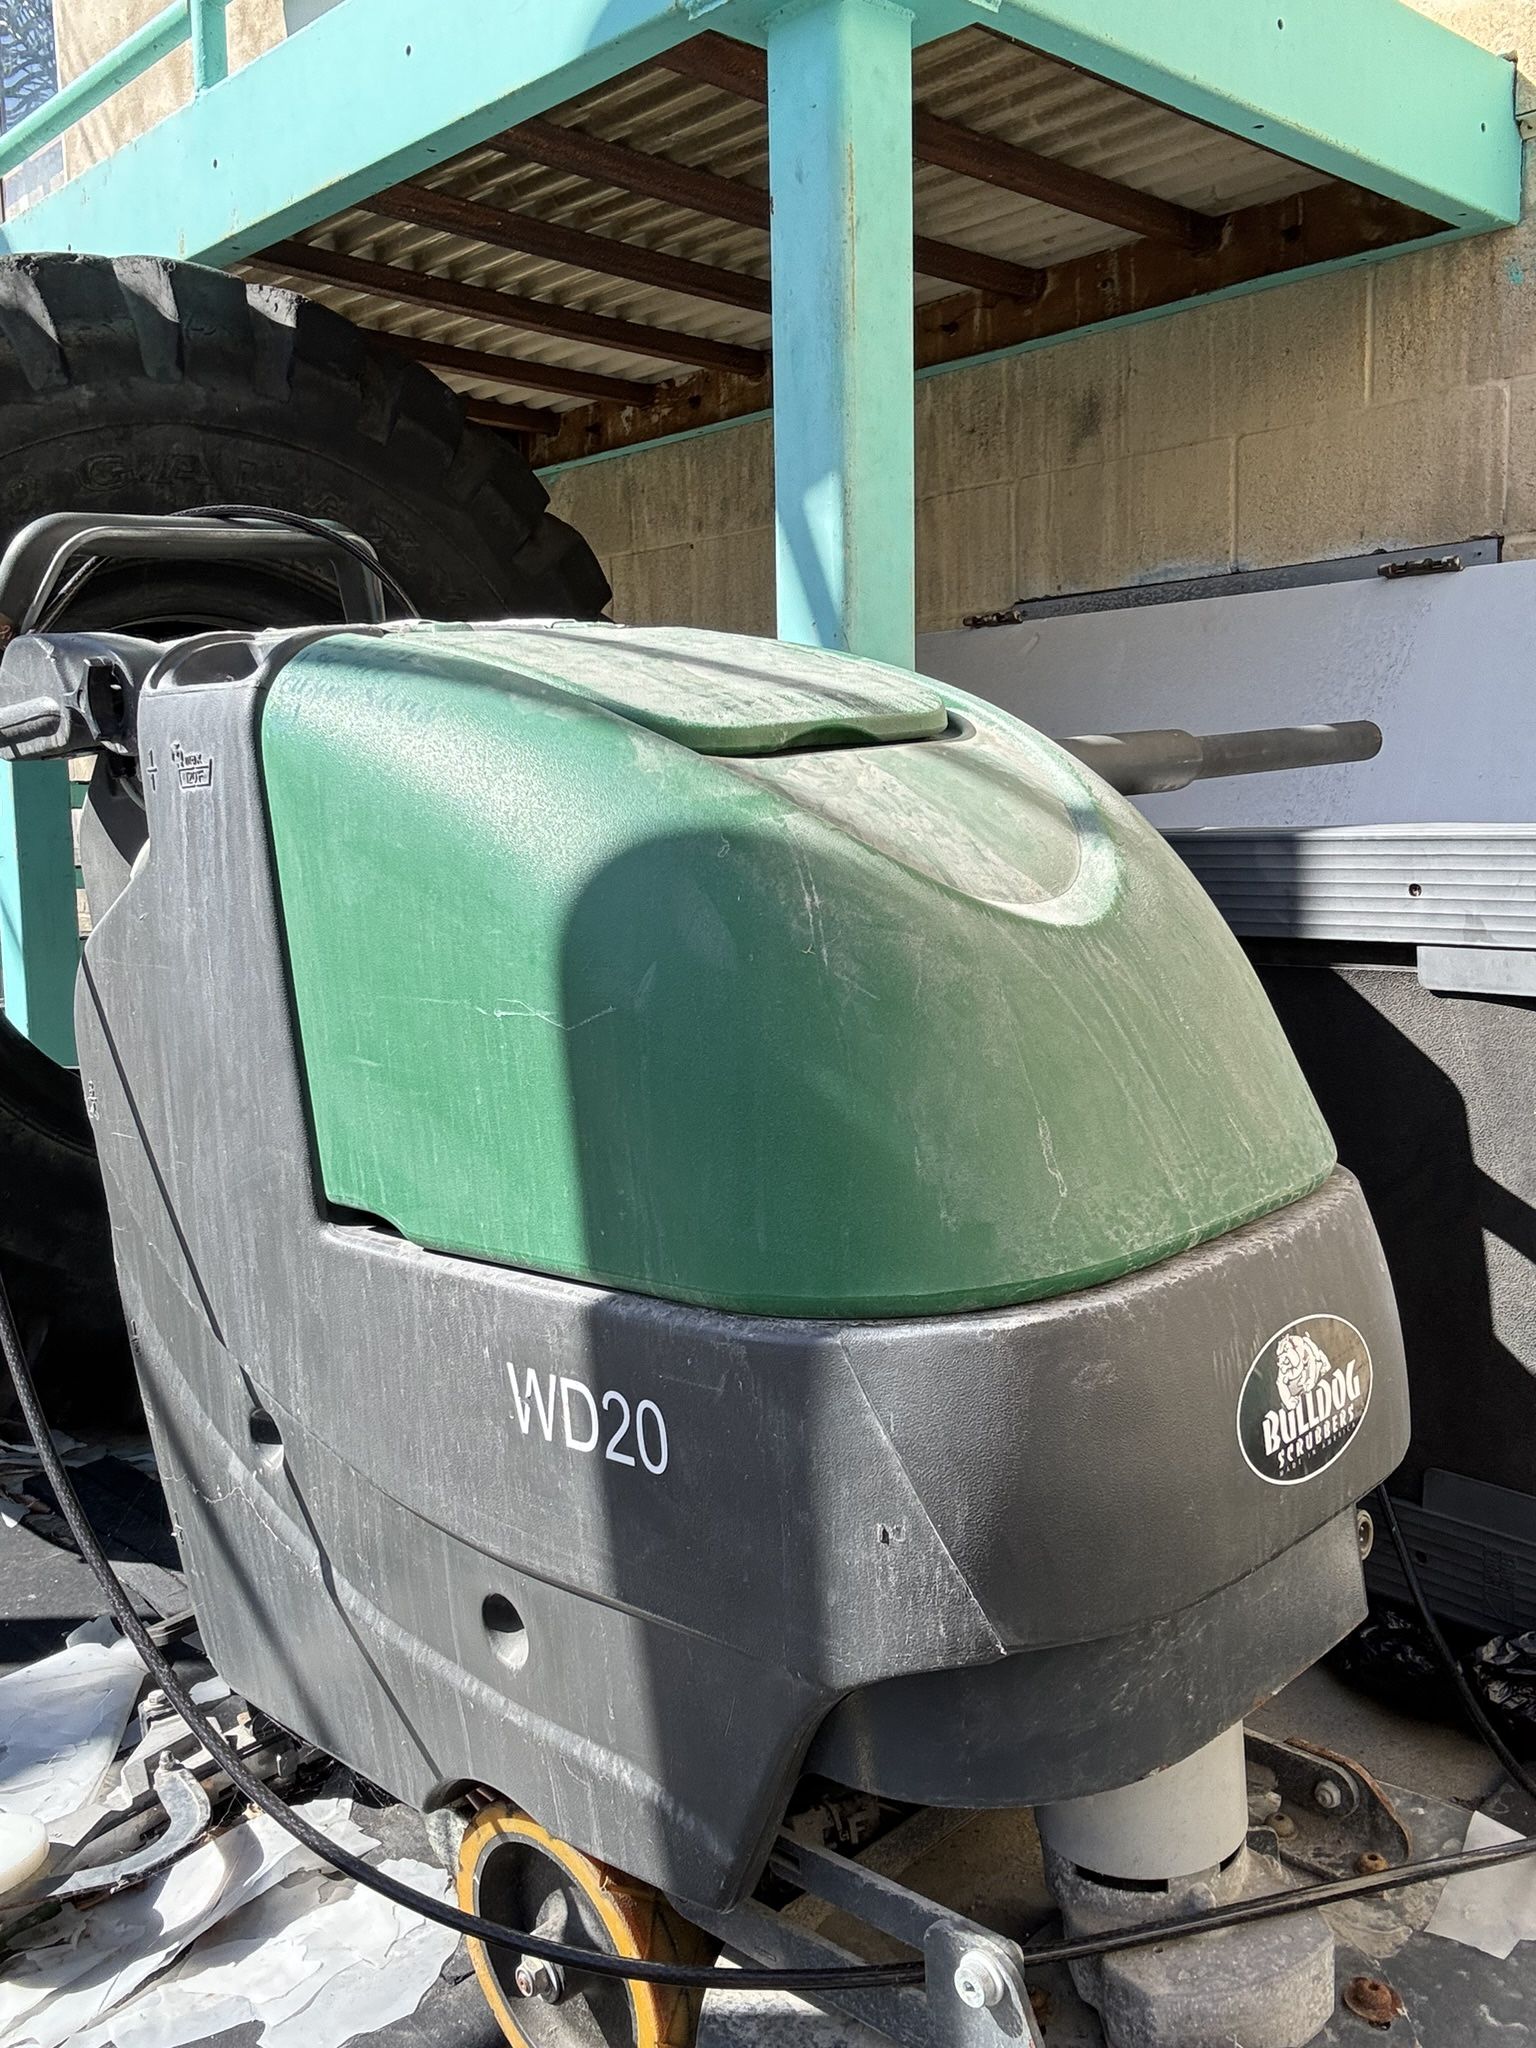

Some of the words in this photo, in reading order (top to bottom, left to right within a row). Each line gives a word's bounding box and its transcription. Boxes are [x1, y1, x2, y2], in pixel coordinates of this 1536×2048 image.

[507, 1362, 668, 1475] WD20
[1262, 1359, 1361, 1456] BULLDOG
[1278, 1403, 1354, 1469] SCRUBBERS
